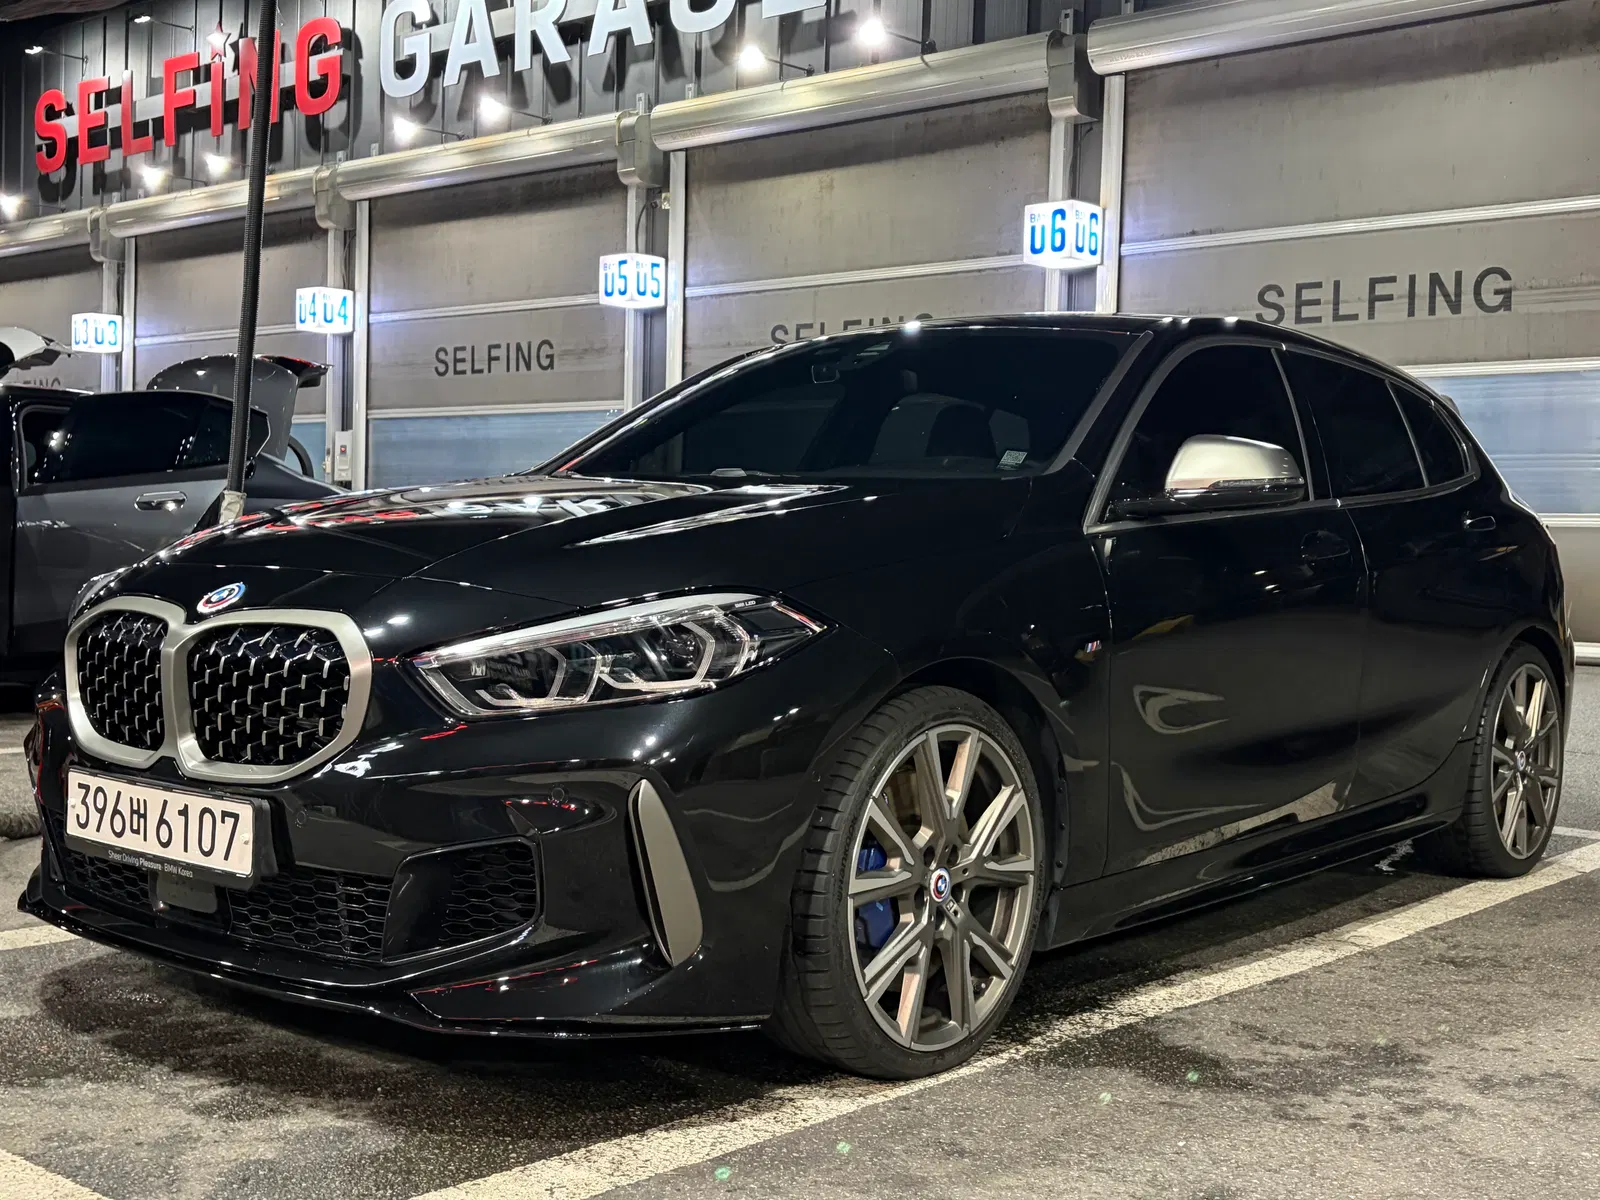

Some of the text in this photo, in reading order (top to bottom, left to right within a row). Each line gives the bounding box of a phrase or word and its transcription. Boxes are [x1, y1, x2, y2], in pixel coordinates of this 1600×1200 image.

[1255, 266, 1513, 326] SELFING
[434, 338, 555, 377] SELFING
[108, 849, 194, 878] Sheer Driving Pleasure BMW Korea
